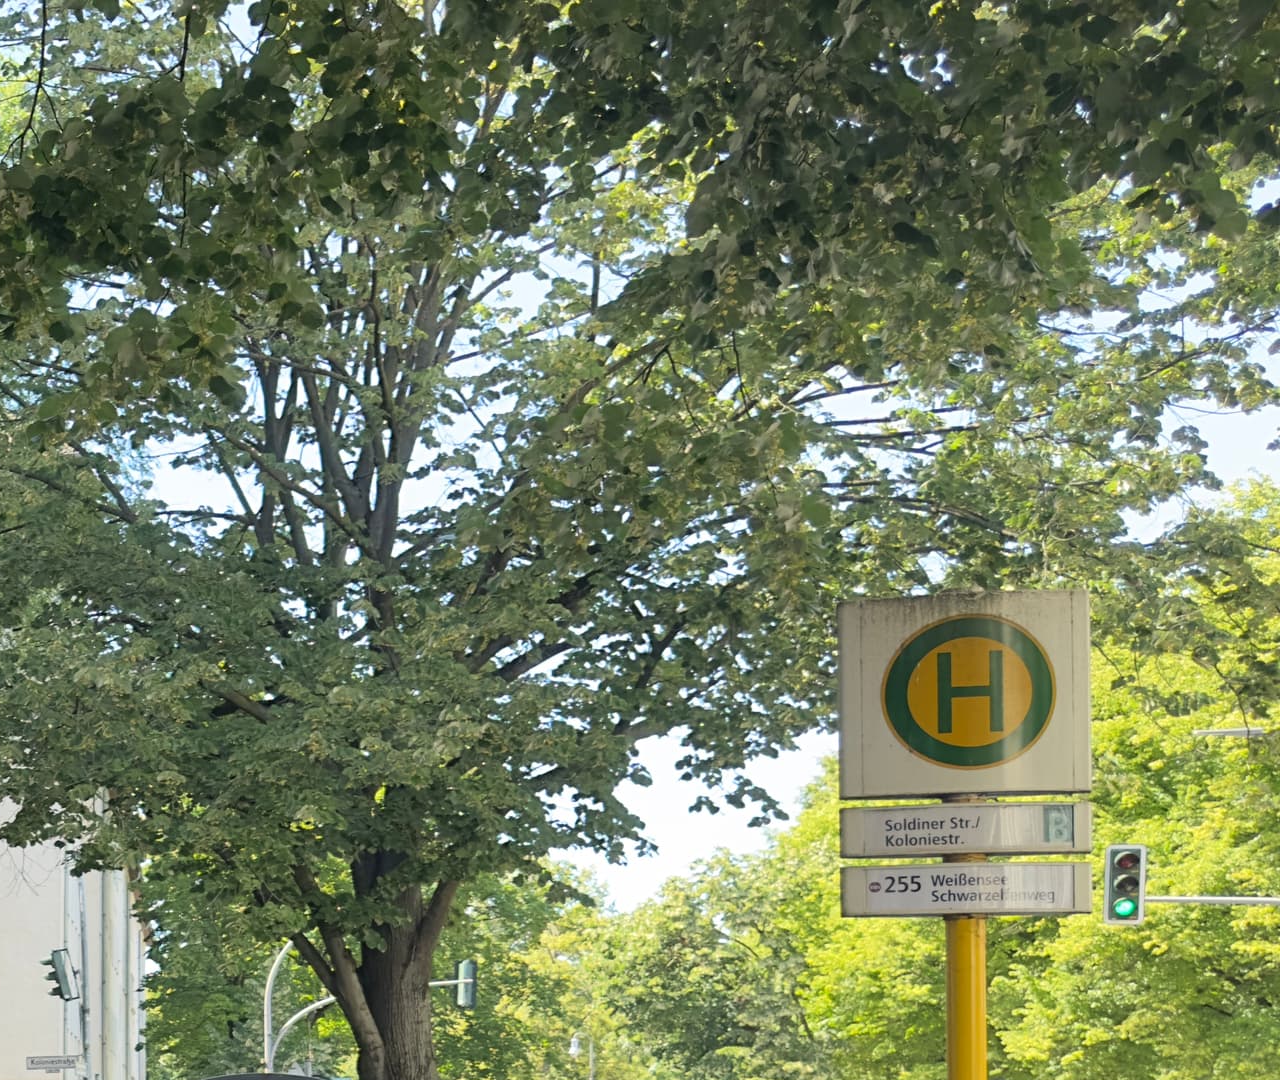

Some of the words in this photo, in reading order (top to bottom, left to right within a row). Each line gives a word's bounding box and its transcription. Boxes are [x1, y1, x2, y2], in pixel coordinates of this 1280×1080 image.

[937, 650, 1003, 733] H
[885, 817, 945, 831] Soldiner
[949, 816, 981, 829] Str./
[885, 833, 965, 847] Koloniestr.
[884, 876, 922, 893] 255
[931, 874, 1008, 887] Weißensee
